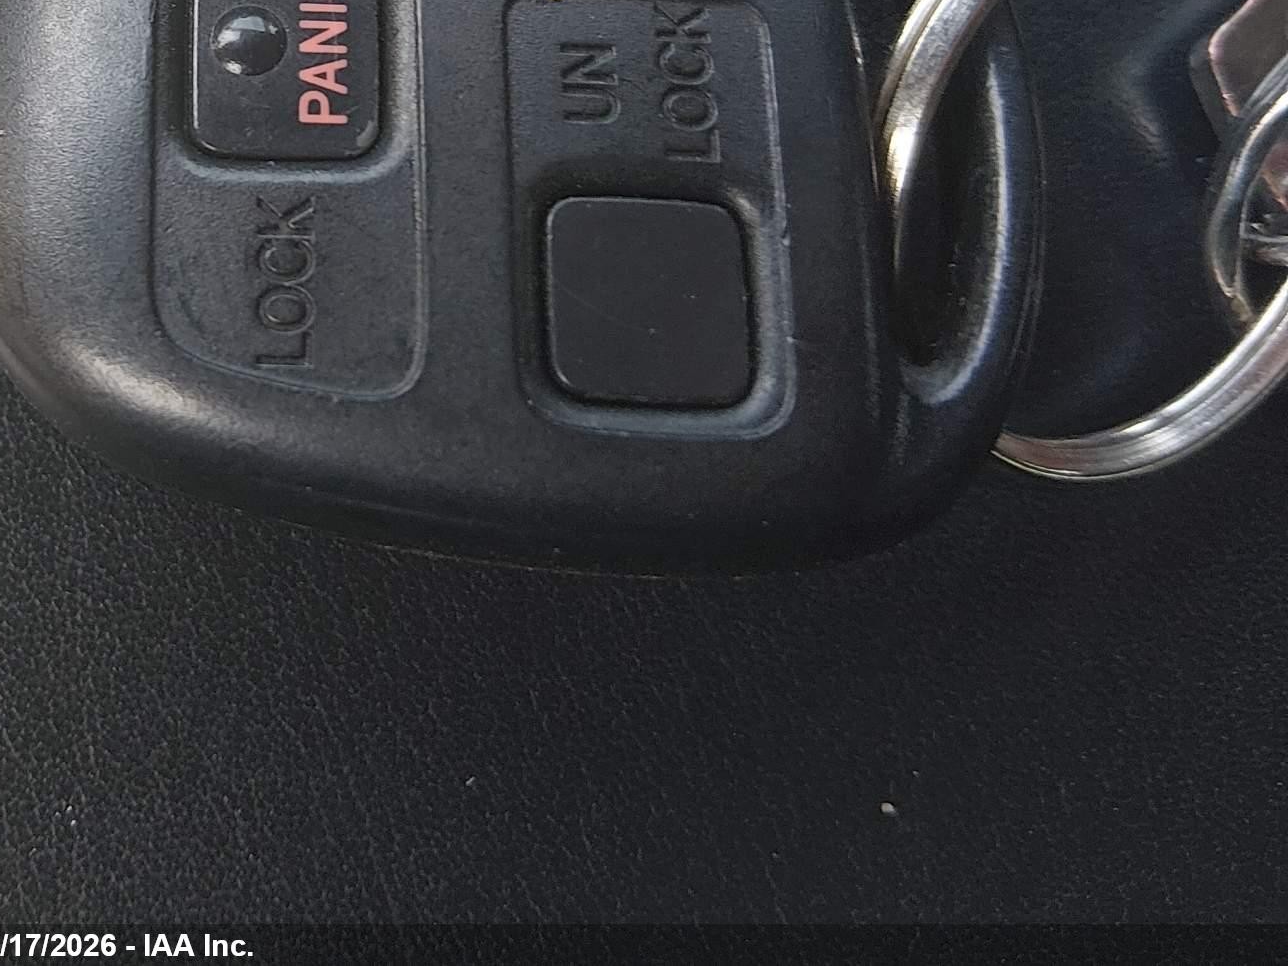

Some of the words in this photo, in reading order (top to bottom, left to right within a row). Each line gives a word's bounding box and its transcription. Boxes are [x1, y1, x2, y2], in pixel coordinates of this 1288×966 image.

[560, 41, 621, 125] UN
[653, 2, 721, 164] LOCK
[255, 195, 317, 369] LOCK
